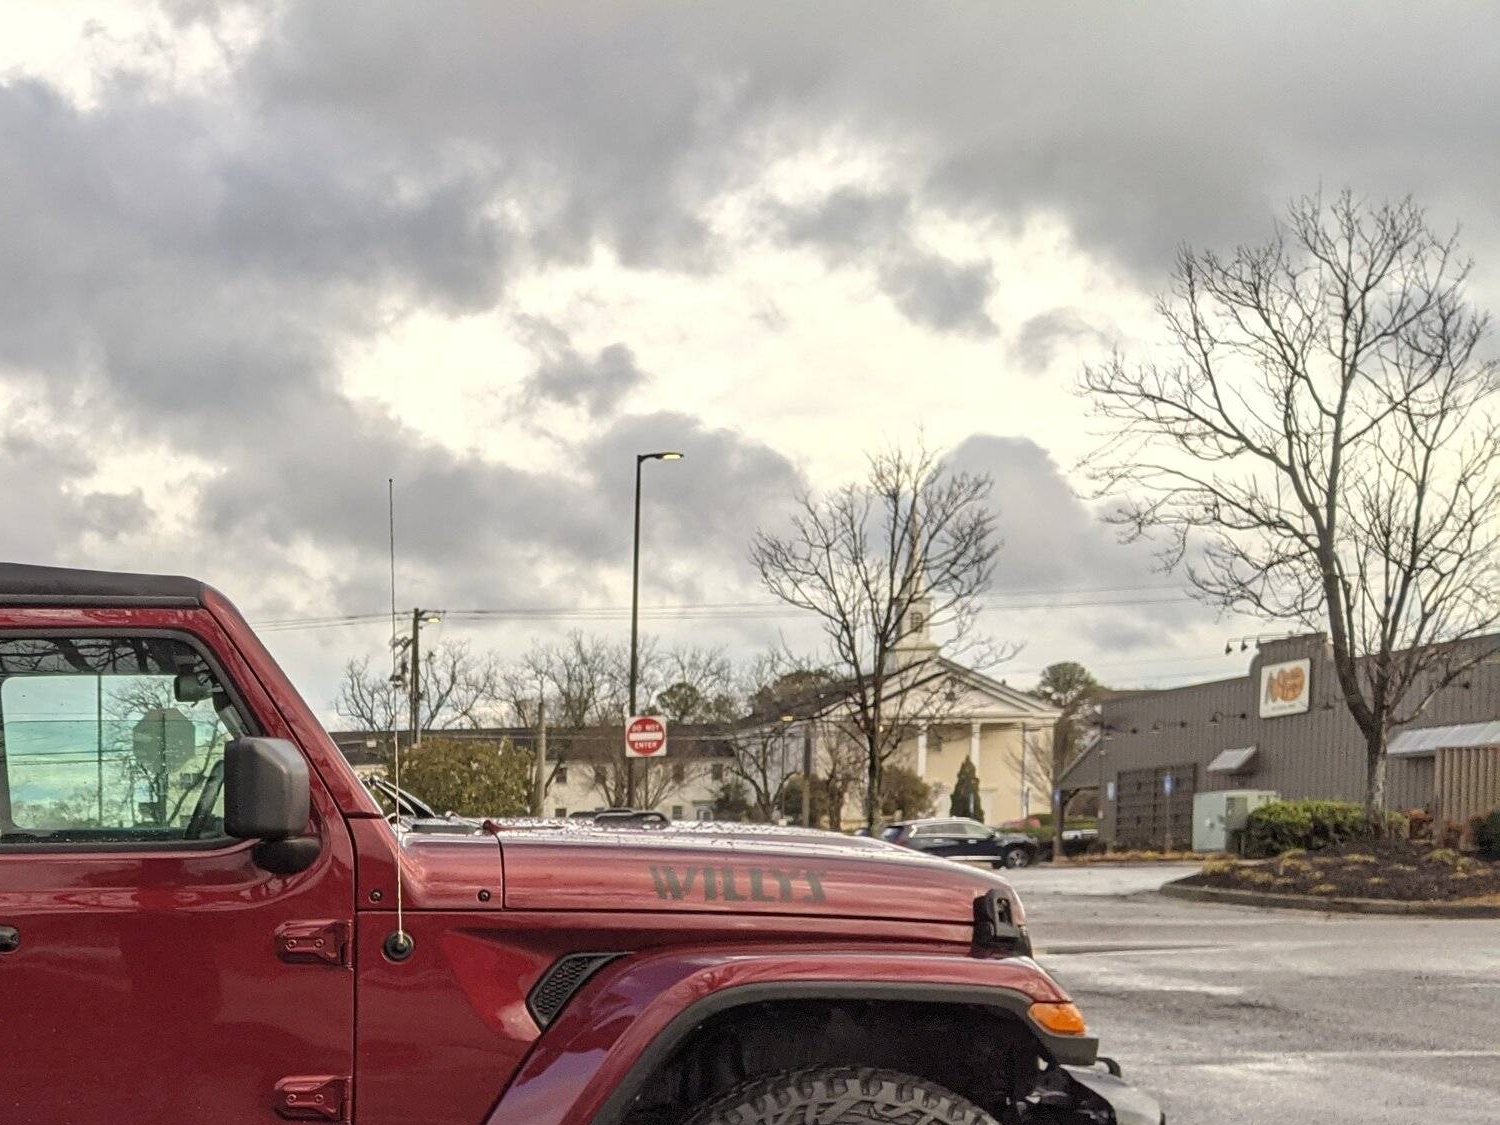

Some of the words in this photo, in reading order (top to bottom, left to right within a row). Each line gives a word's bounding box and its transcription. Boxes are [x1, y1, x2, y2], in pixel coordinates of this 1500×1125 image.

[631, 724, 642, 732] DO
[645, 724, 660, 732] NOT
[634, 741, 657, 749] ENTER
[648, 864, 827, 903] WILLYS
